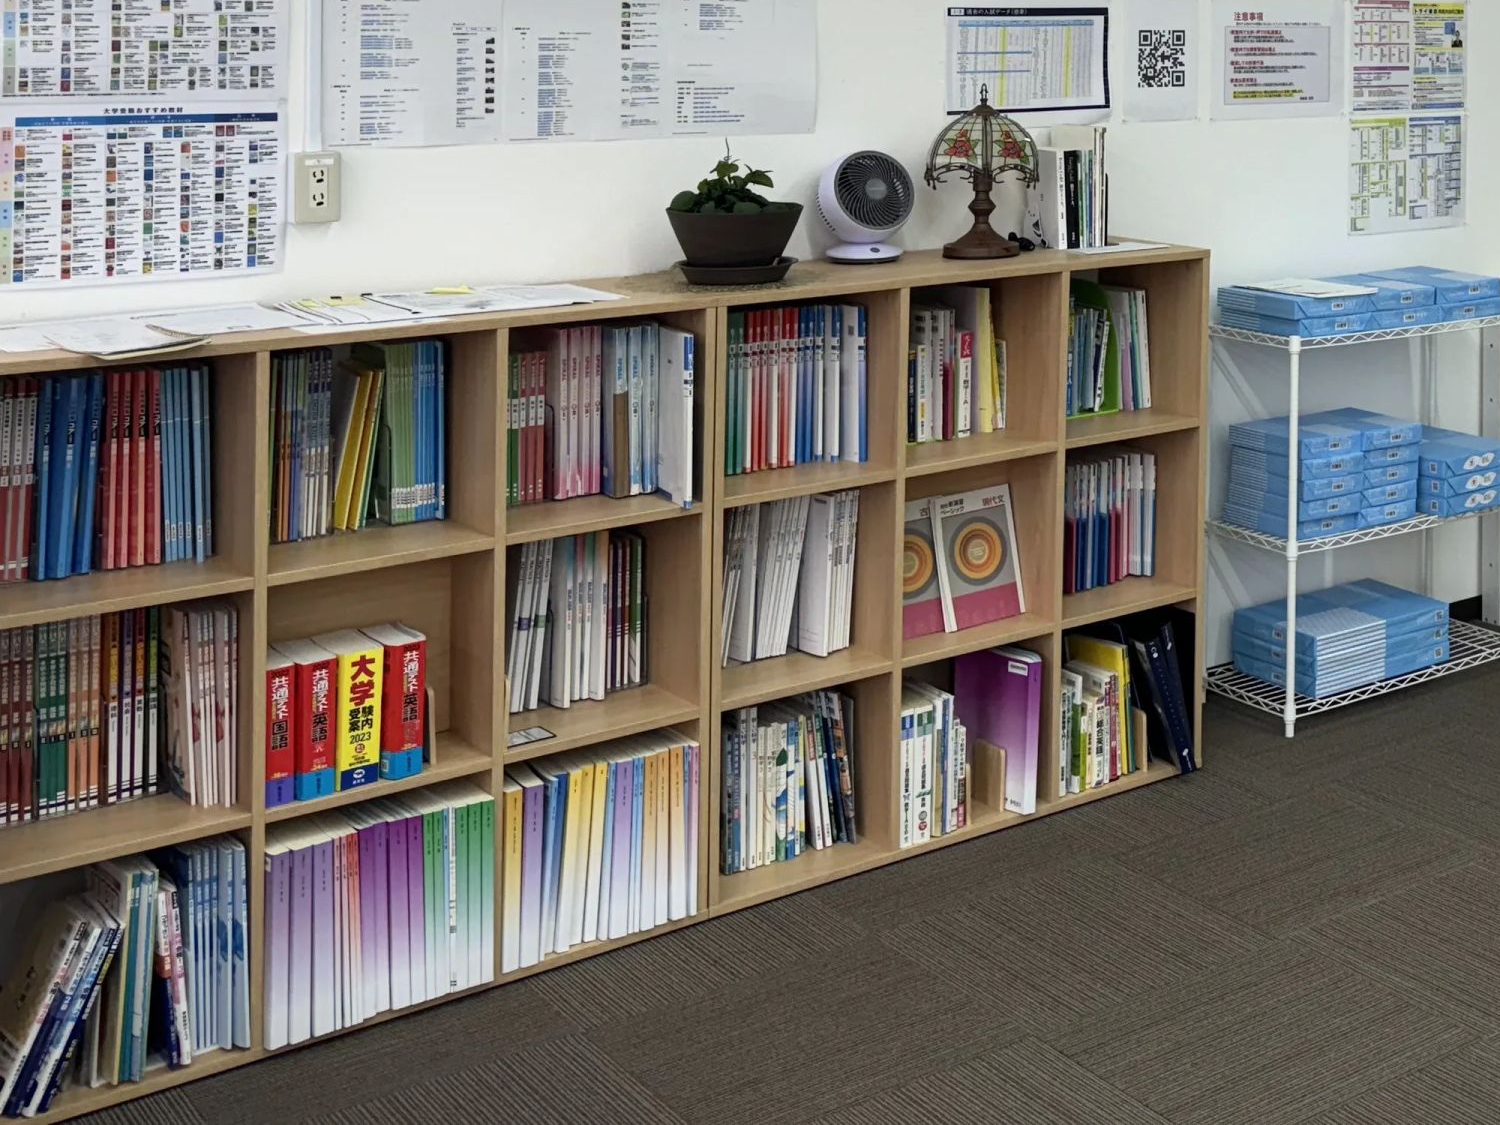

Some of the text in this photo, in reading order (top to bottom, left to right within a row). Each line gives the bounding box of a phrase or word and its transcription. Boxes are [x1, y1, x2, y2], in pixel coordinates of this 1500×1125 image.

[350, 655, 376, 706] 大学
[403, 651, 420, 692] 共通テスト
[272, 677, 289, 720] 共通テスト
[312, 669, 329, 713] 共通テスト
[403, 693, 418, 722] 英語
[272, 721, 288, 750] 国語
[312, 713, 328, 743] 英語
[350, 732, 371, 744] 2023
